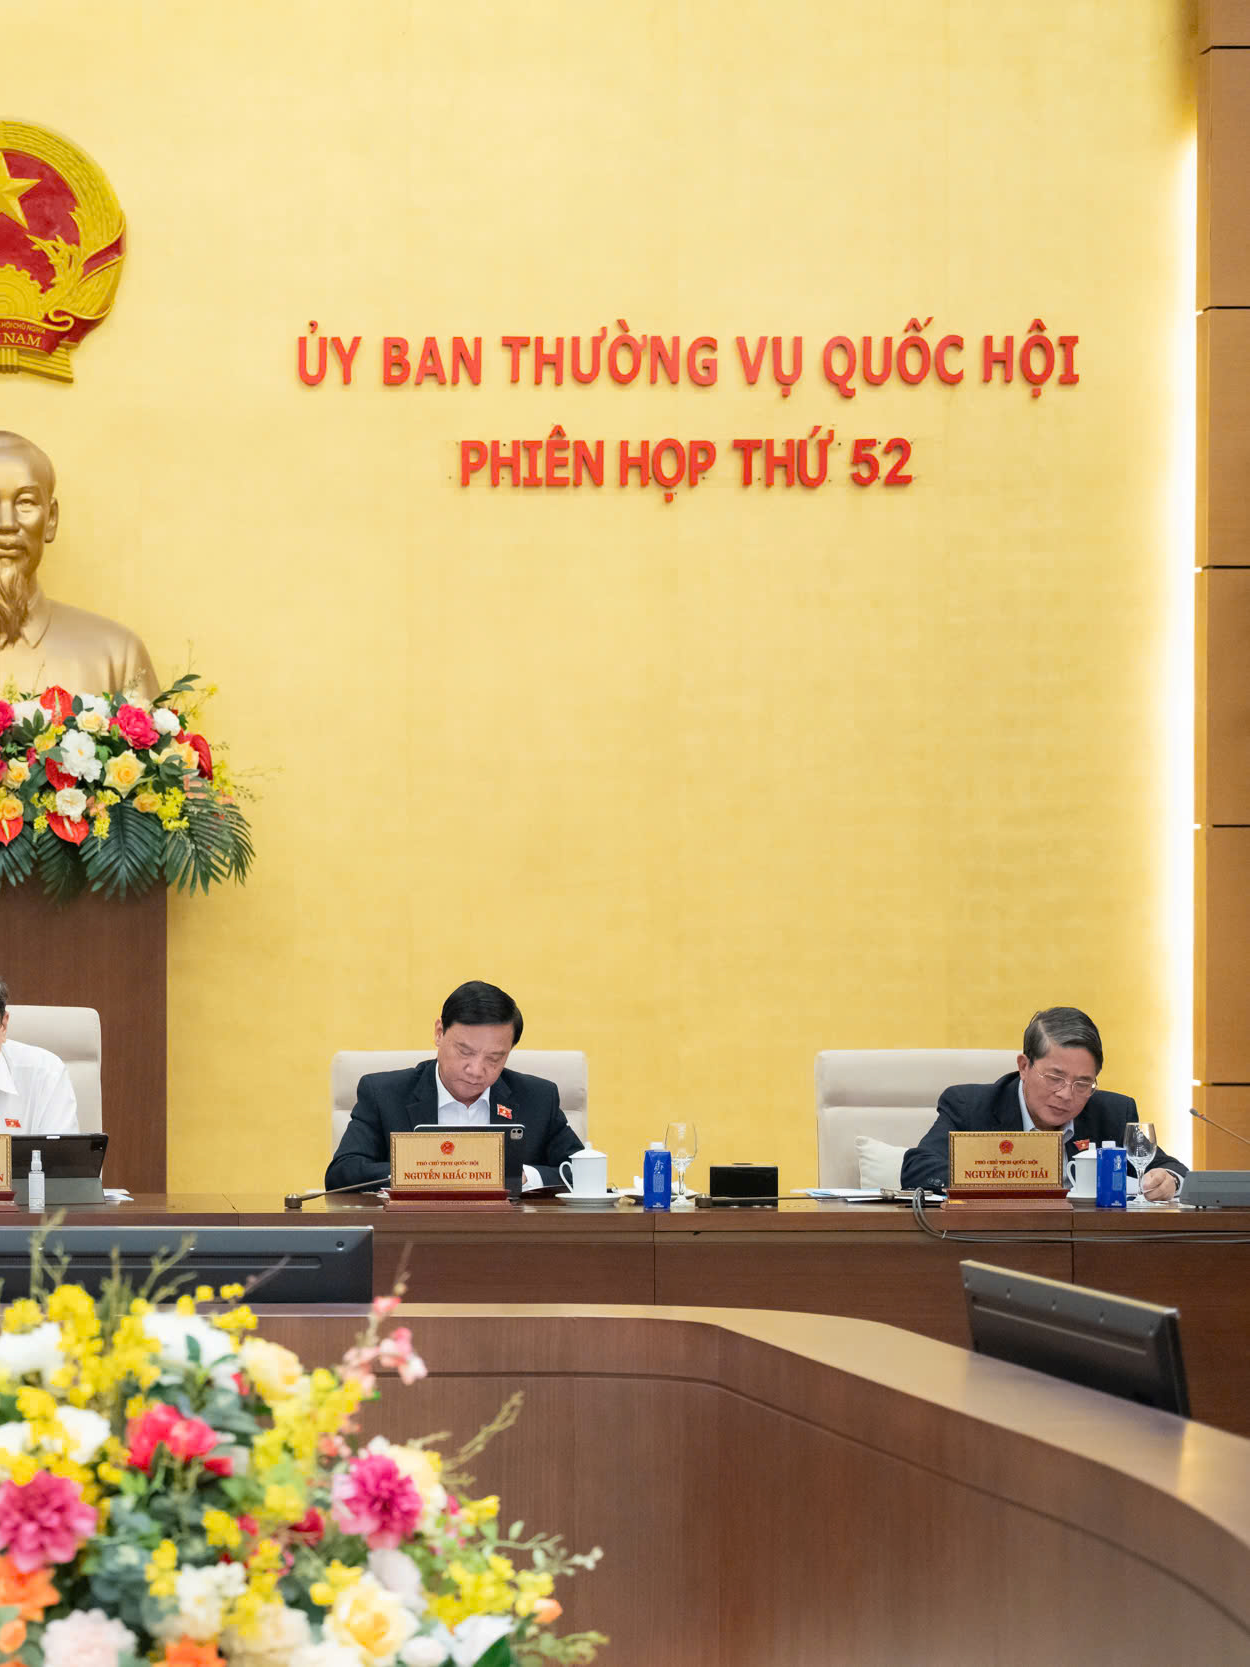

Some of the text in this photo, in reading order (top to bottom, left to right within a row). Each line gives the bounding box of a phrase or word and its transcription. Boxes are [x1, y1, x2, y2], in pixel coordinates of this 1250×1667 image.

[2, 332, 42, 347] NAM
[297, 317, 1080, 399] ỦY BAN THƯỜNG VỤ QUỐC HỘI
[460, 425, 914, 503] PHIÊN HỌP THỨ 52
[442, 1168, 468, 1180] KHẮC
[469, 1172, 492, 1181] ĐỊNH
[964, 1166, 1005, 1178] NGUYỄN
[1007, 1168, 1028, 1178] ĐỨC
